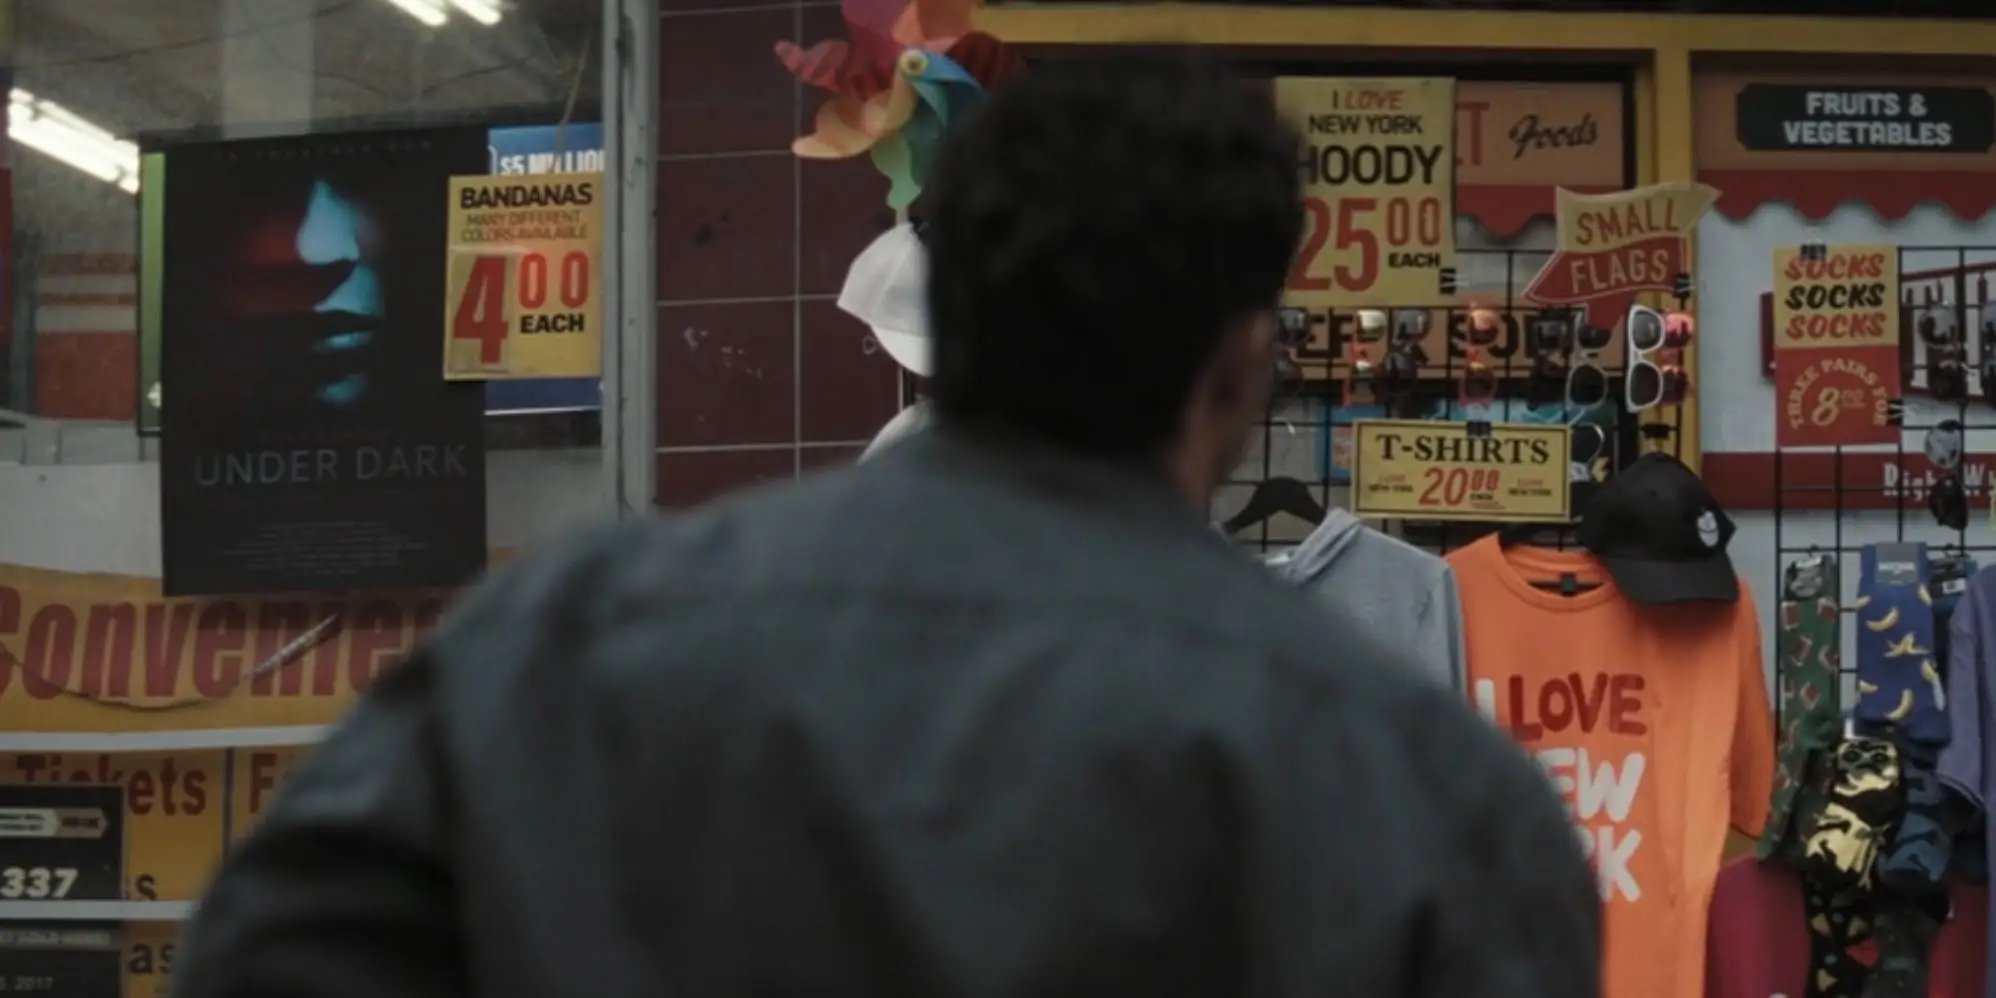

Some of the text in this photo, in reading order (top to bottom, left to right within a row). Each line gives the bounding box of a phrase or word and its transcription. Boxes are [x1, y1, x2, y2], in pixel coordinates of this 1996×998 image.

[1332, 89, 1405, 110] I LOVE
[1805, 91, 1929, 117] FRUITS &
[1308, 114, 1423, 134] NEW YORK
[1508, 112, 1598, 160] Foods
[1782, 120, 1953, 146] VEGETABLES
[460, 183, 593, 209] BANDANAS
[510, 210, 581, 225] DIFFERENT
[1575, 196, 1679, 246] SMALL
[1388, 252, 1440, 268] EACH
[1569, 248, 1669, 294] FLAGS
[1785, 253, 1885, 281] SOCKS
[1785, 282, 1886, 310] SOCKS
[519, 314, 585, 334] EACH
[1786, 312, 1887, 339] SOCKS
[1788, 365, 1820, 430] THREE
[1820, 358, 1878, 387] PAIRS
[1375, 434, 1550, 464] T-SHIRTS
[193, 443, 469, 488] UNDER DARK
[1508, 671, 1649, 741] LOVE
[1532, 746, 1647, 823] EW
